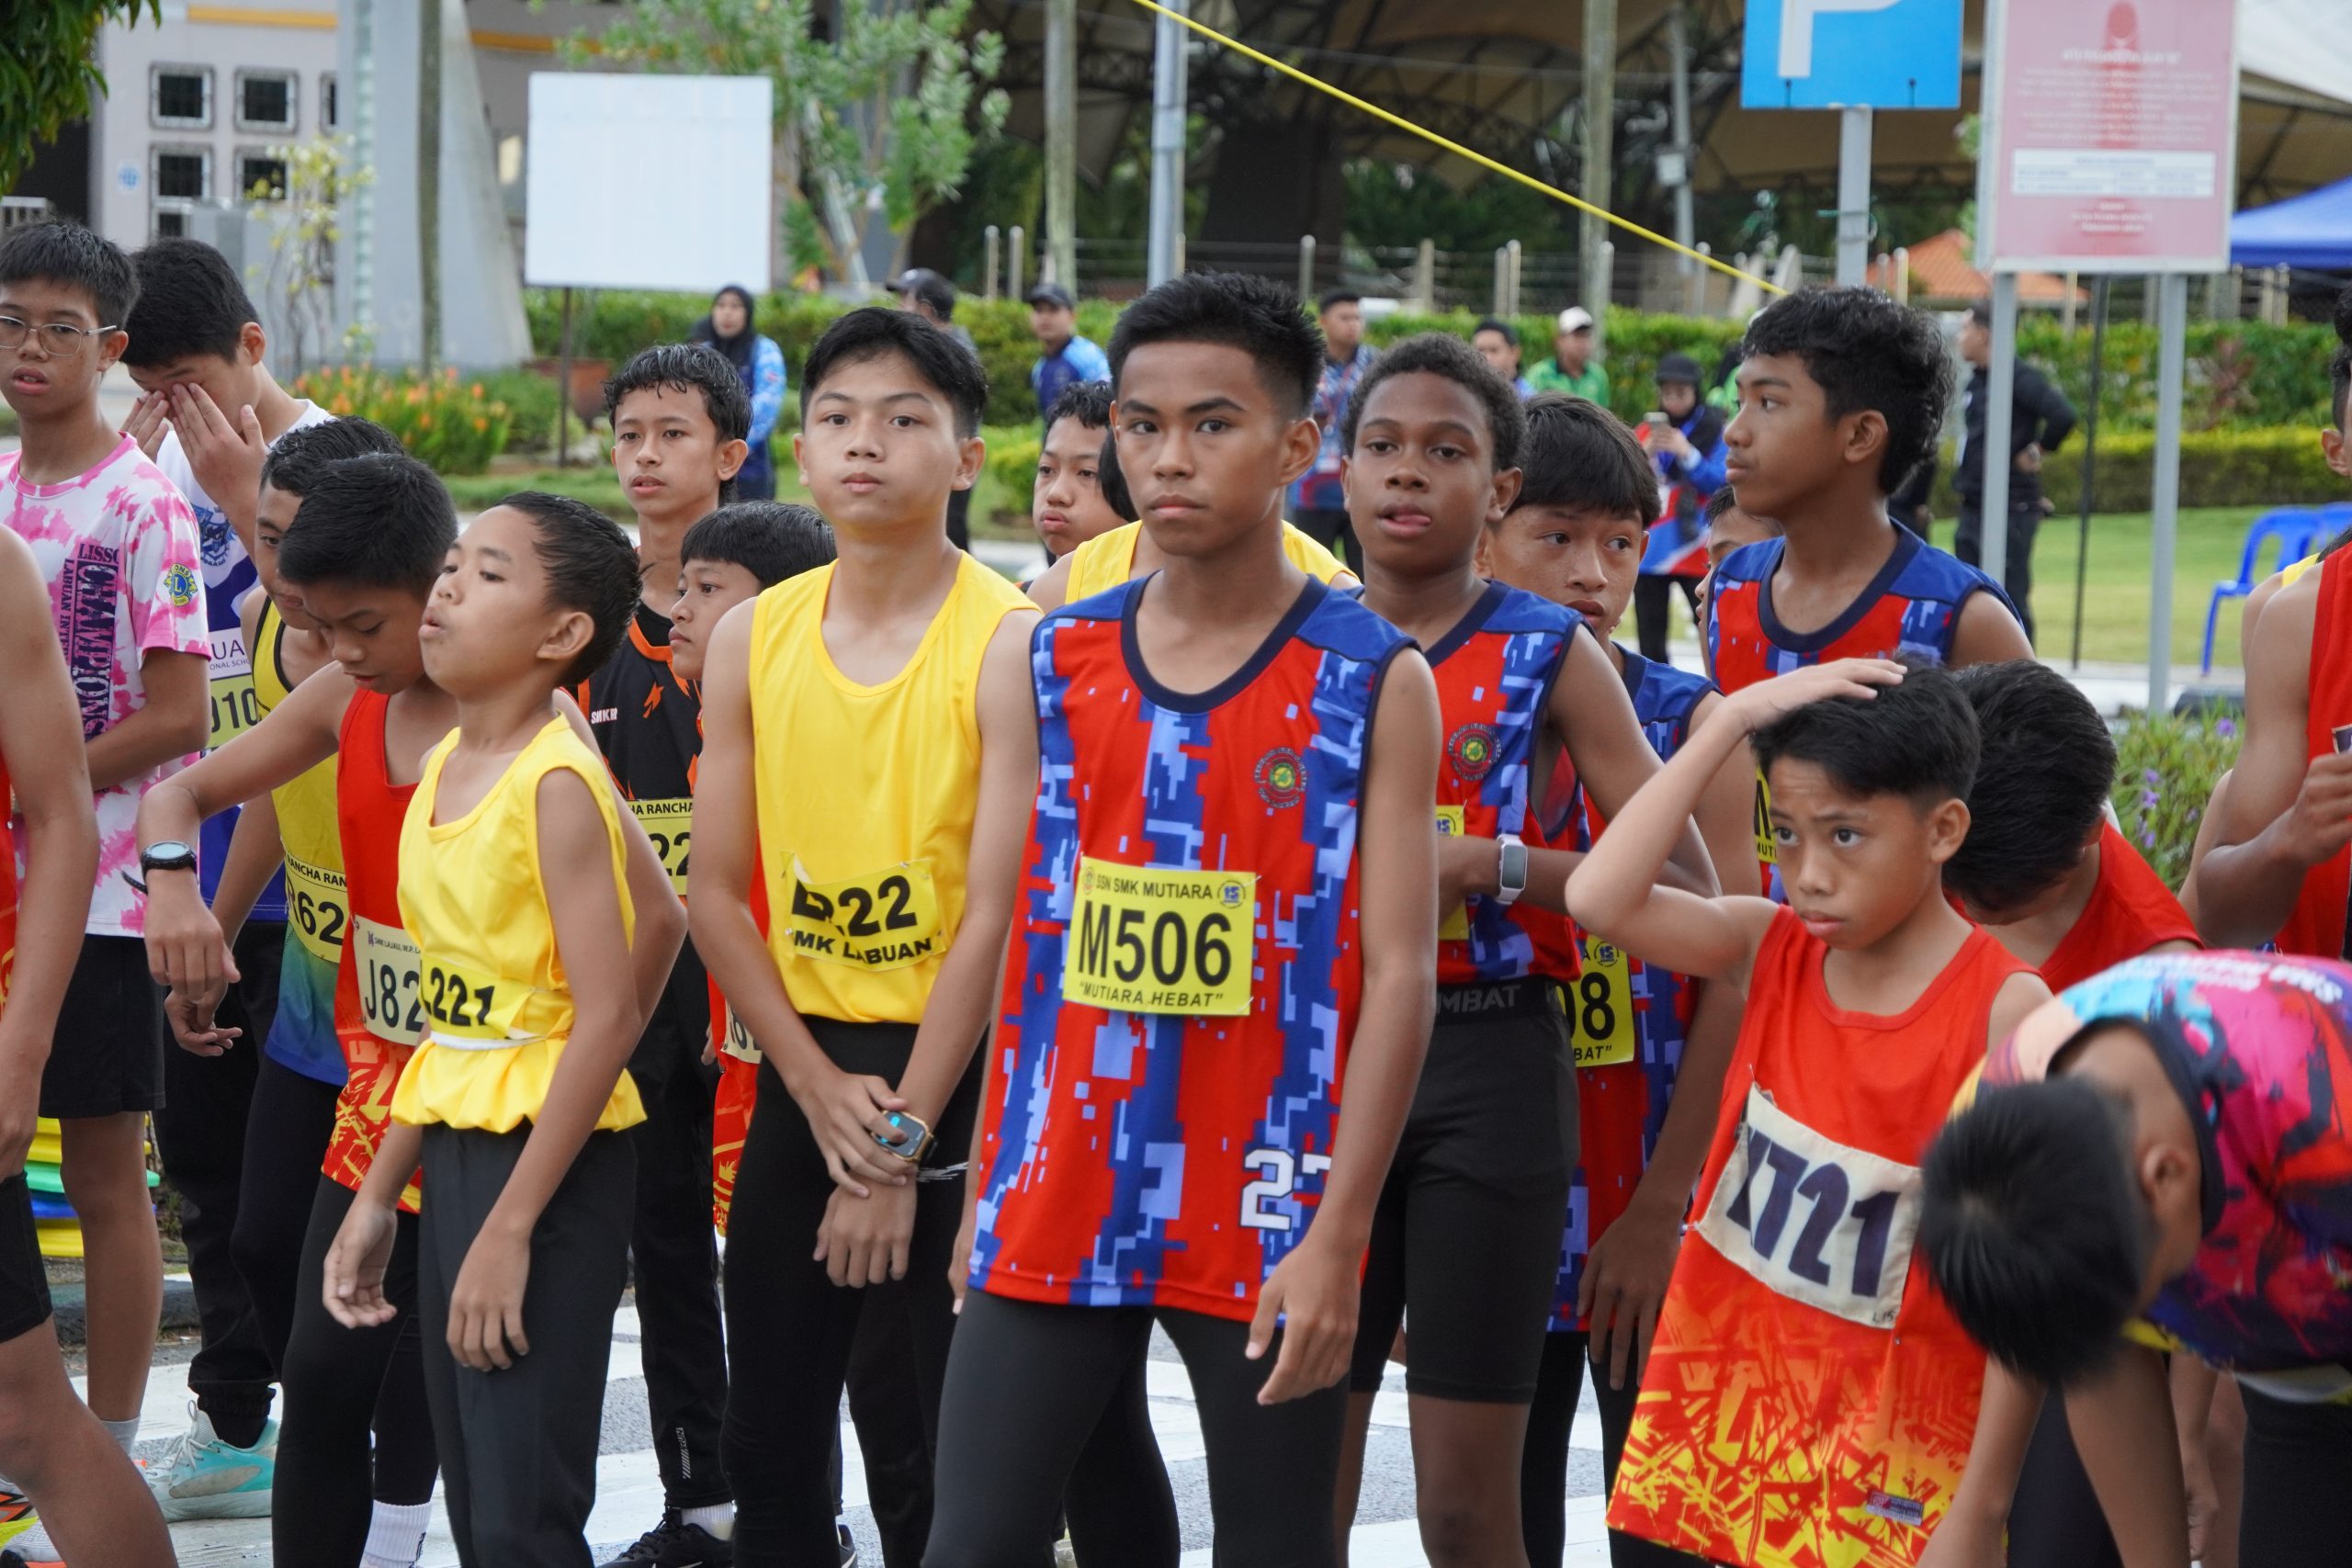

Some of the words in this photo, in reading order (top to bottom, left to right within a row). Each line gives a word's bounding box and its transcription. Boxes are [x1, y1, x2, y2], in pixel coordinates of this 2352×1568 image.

[1114, 877, 1139, 896] SMK
[1143, 883, 1214, 900] MUTIARA
[1079, 899, 1232, 987] M506
[365, 959, 425, 1032] J82
